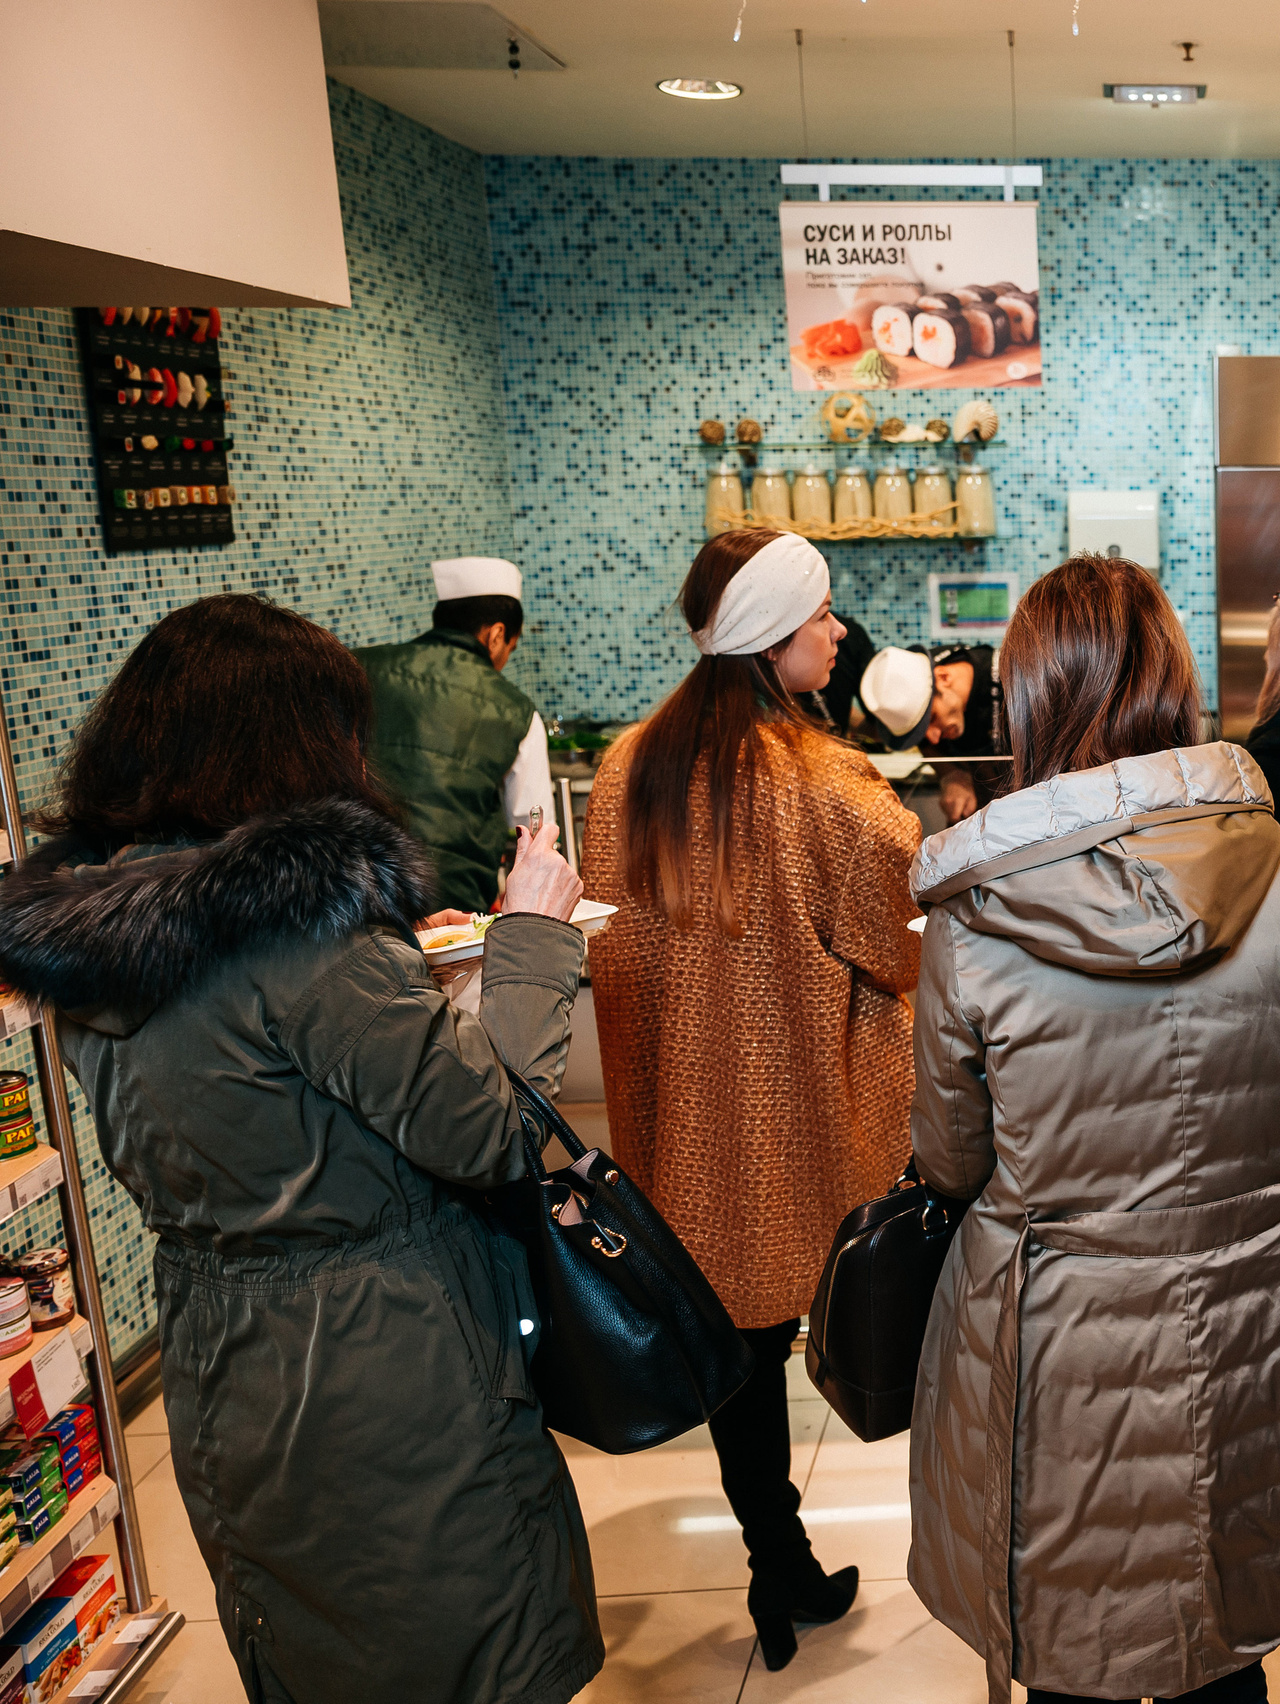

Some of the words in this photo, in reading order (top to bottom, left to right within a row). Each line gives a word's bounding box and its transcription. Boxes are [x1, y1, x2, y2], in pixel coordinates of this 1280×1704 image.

[803, 224, 855, 242] СУСИ
[862, 224, 875, 242] И
[882, 224, 952, 241] РОЛЛЫ
[805, 247, 831, 265] НА
[837, 247, 906, 265] ЗАКАЗ!
